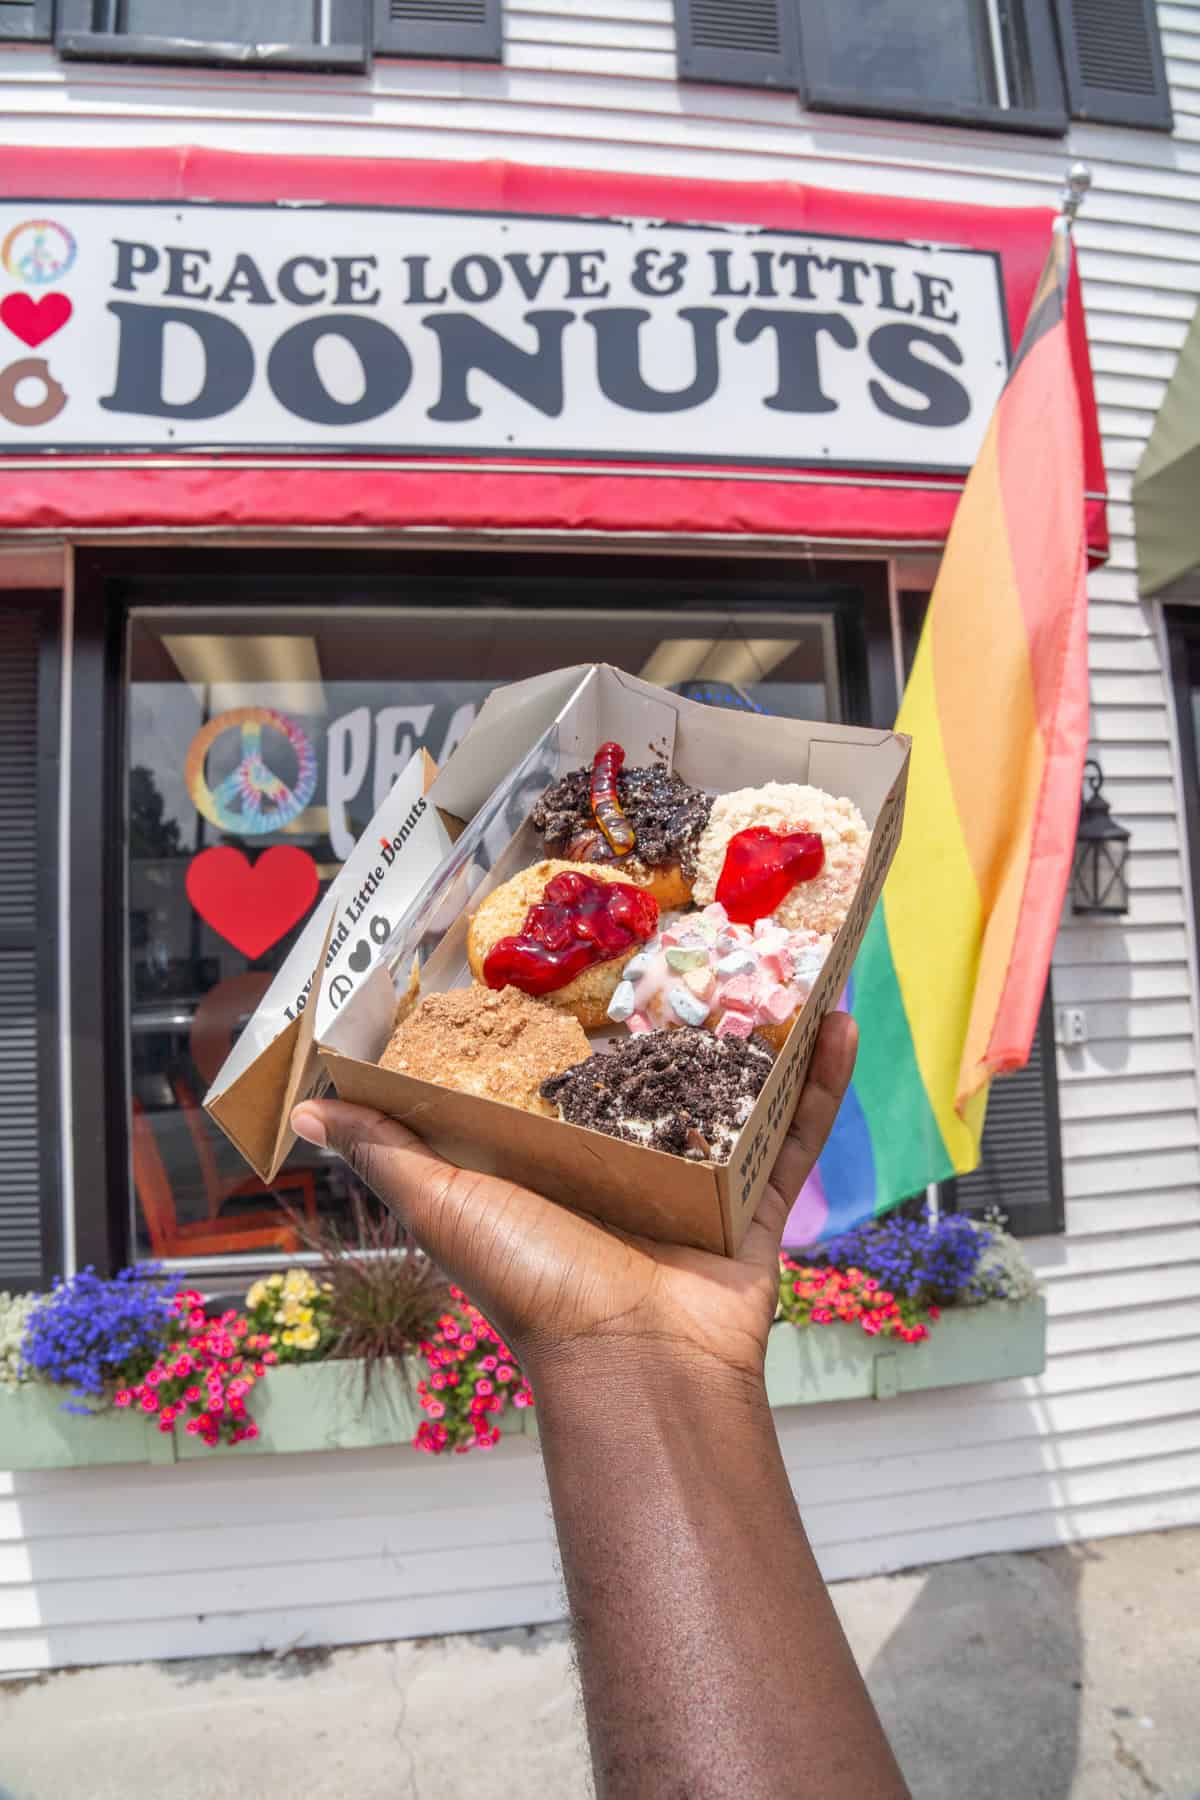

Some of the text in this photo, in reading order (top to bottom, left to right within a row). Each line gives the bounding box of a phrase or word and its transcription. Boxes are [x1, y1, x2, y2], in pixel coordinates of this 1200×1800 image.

[111, 240, 957, 325] PEACE LOVE & LITTLE
[98, 301, 971, 427] DONUTS
[284, 969, 316, 1021] Lov
[345, 866, 385, 924] Little
[381, 797, 427, 867] Donuts
